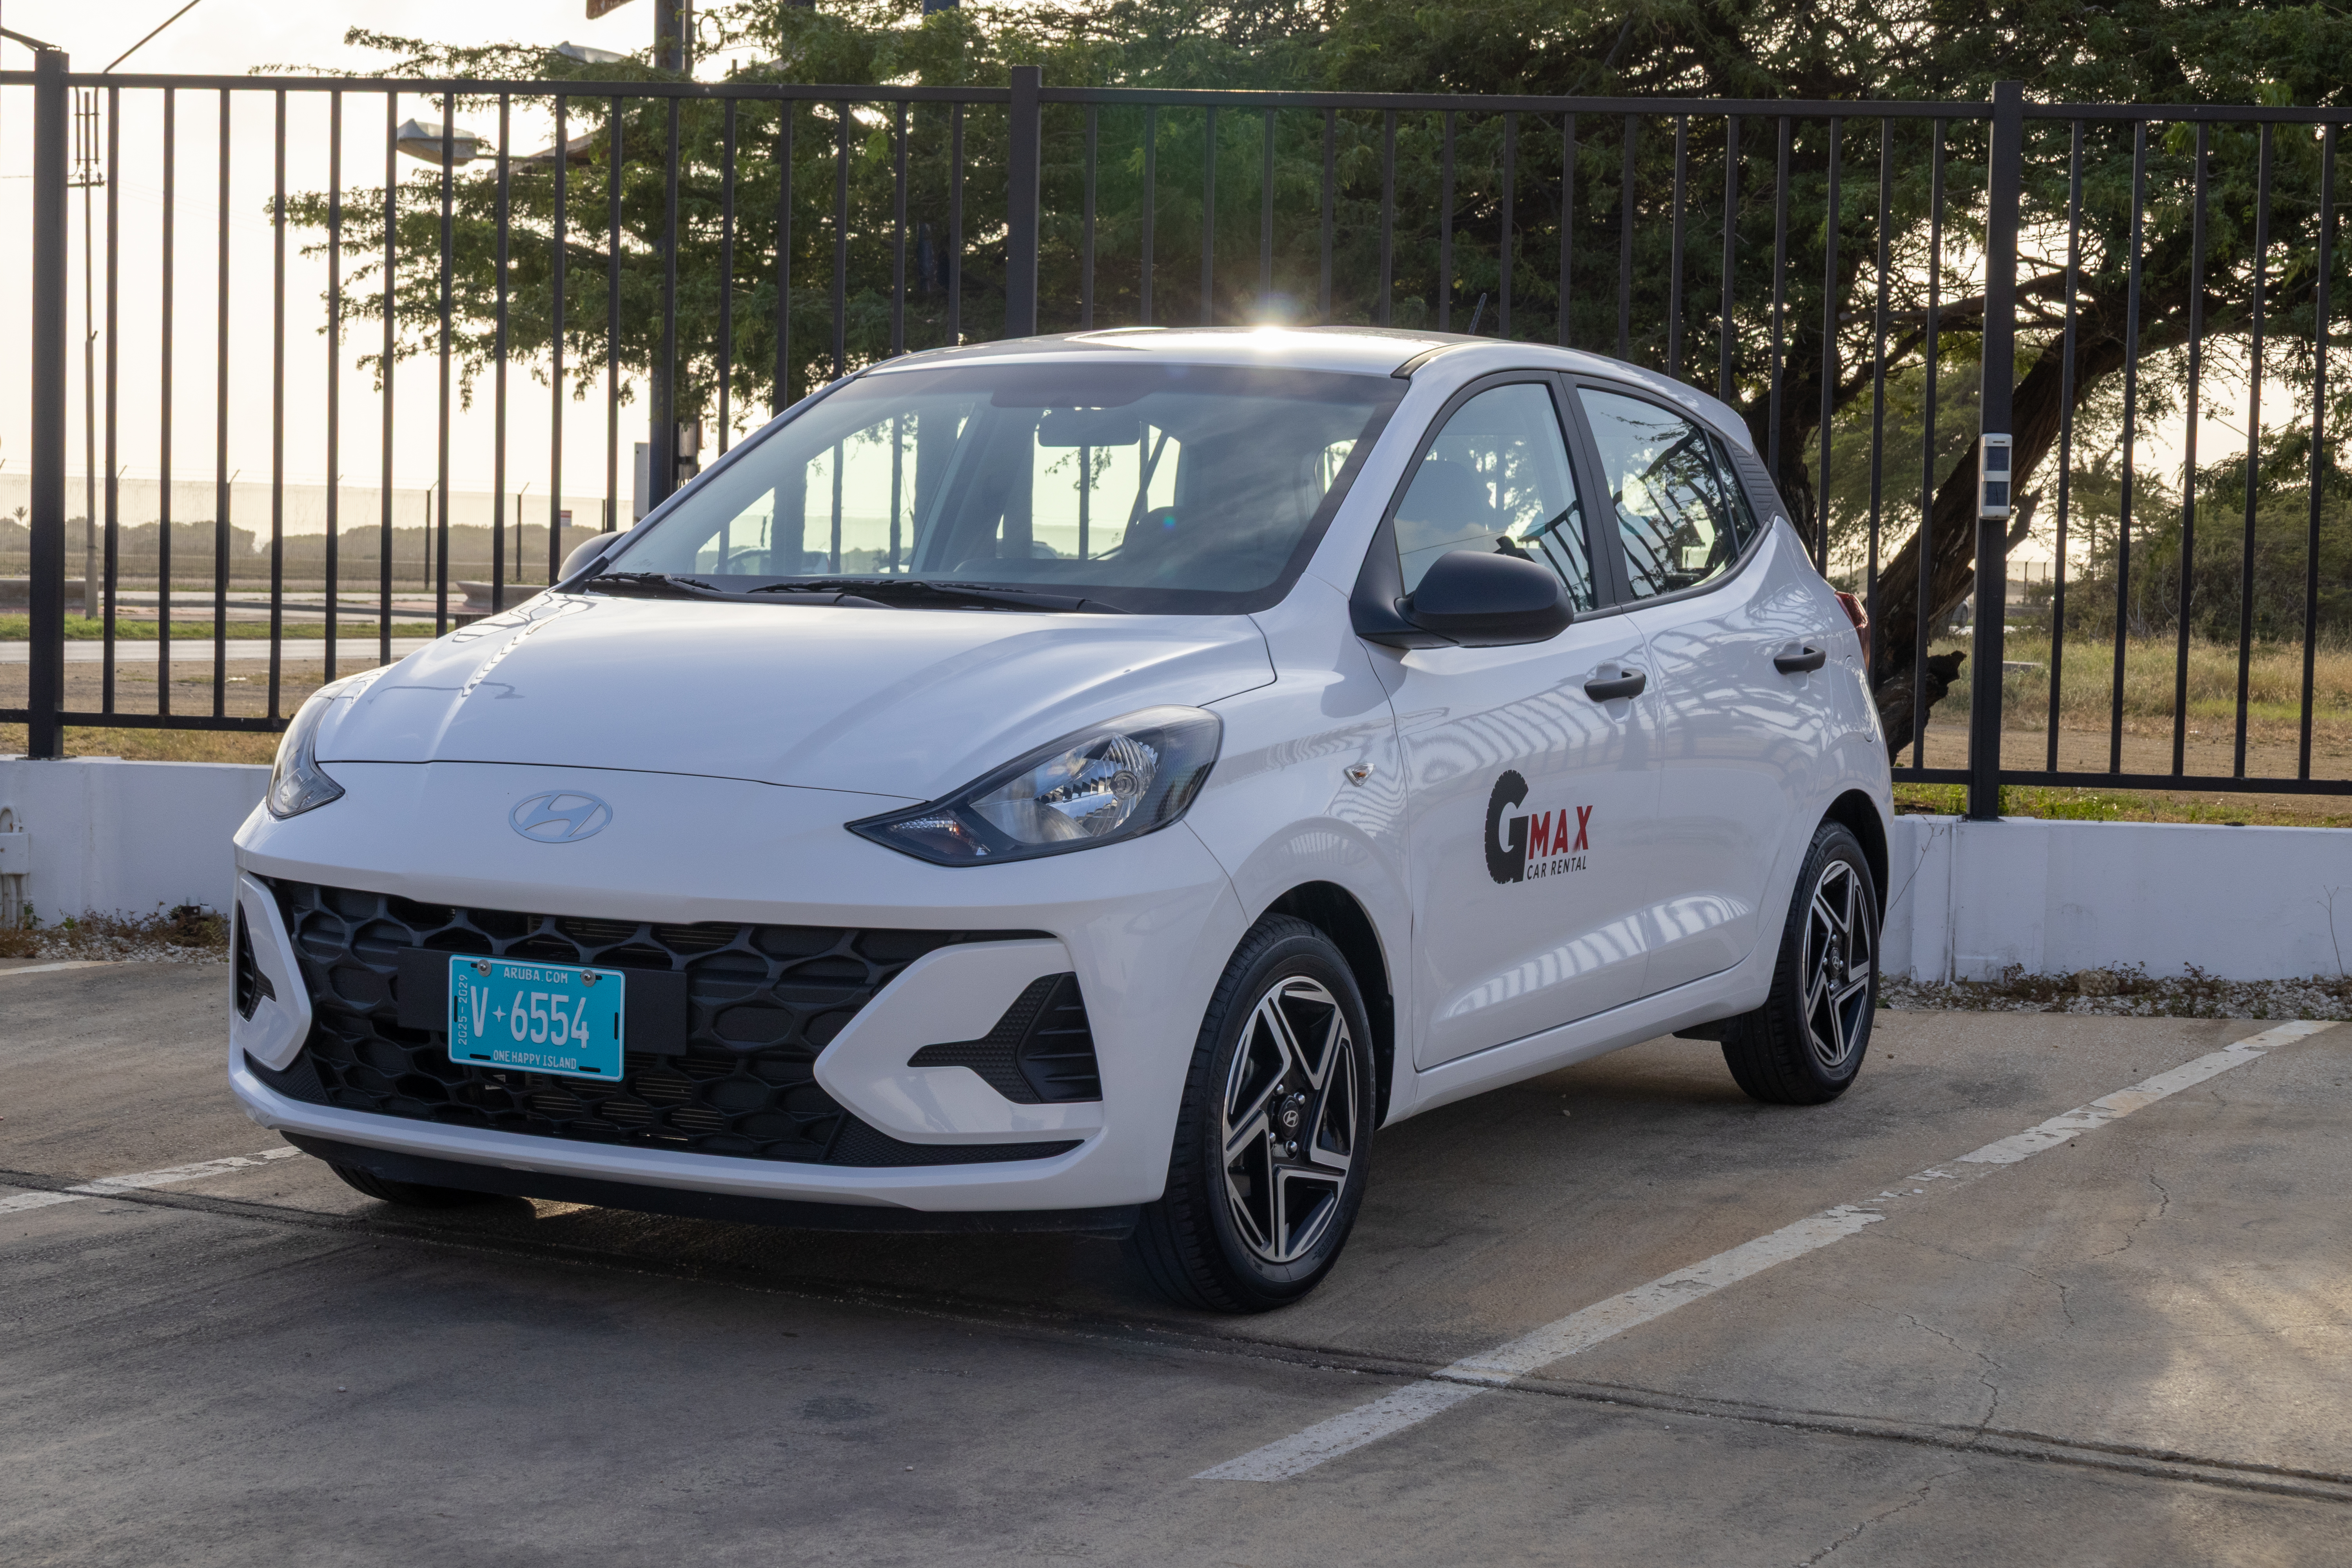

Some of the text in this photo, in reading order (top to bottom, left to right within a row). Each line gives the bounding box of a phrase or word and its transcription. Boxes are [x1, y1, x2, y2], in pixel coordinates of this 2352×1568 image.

[1527, 855, 1586, 880] CAR RENTAL
[458, 974, 468, 1046] 2025-2029
[510, 991, 589, 1049] 6554
[493, 1049, 577, 1070] ONE HAPPY ISLAND
